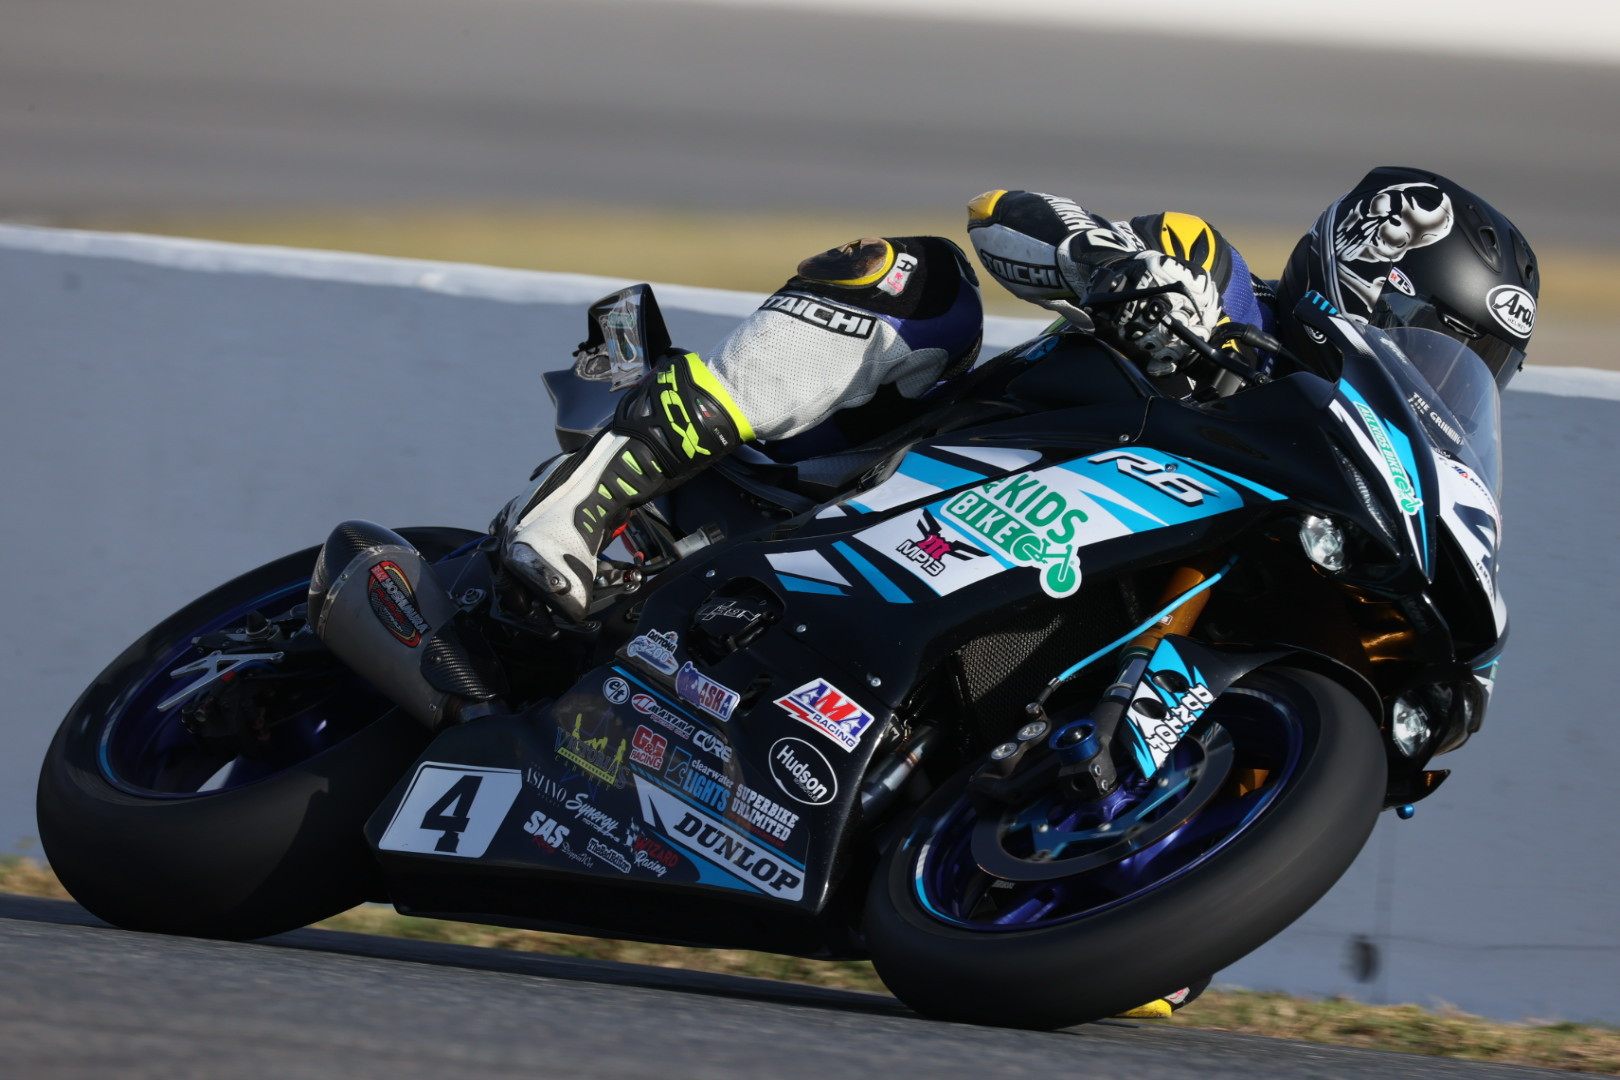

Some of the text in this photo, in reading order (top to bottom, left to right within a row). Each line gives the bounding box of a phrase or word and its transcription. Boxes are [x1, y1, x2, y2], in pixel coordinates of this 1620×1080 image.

[763, 295, 872, 335] TAICHI
[1493, 293, 1535, 329] Arai
[1358, 402, 1402, 475] ALL KIDS BIKE
[950, 493, 1021, 544] BIKE
[993, 473, 1088, 544] KIDS
[896, 539, 946, 577] MP13
[381, 577, 431, 635] YOSHIMURA
[645, 642, 670, 663] 200
[647, 630, 678, 653] DAYTONA
[699, 681, 732, 718] ASRA
[793, 682, 871, 738] AMA
[648, 705, 694, 736] MAXIMA
[812, 713, 856, 748] RACING
[630, 748, 662, 770] RACING
[632, 726, 667, 758] G&G
[683, 770, 730, 812] LIGHTS
[691, 759, 734, 788] clearwater
[776, 745, 828, 799] Hudson
[420, 775, 483, 854] 4
[565, 792, 620, 836] Synergy
[731, 798, 791, 842] UNLIMITED
[736, 783, 800, 829] SUPERBIKE
[523, 810, 570, 849] SAS
[633, 849, 668, 878] Racing
[634, 834, 679, 868] WIZARD
[674, 812, 801, 891] DUNLOP
